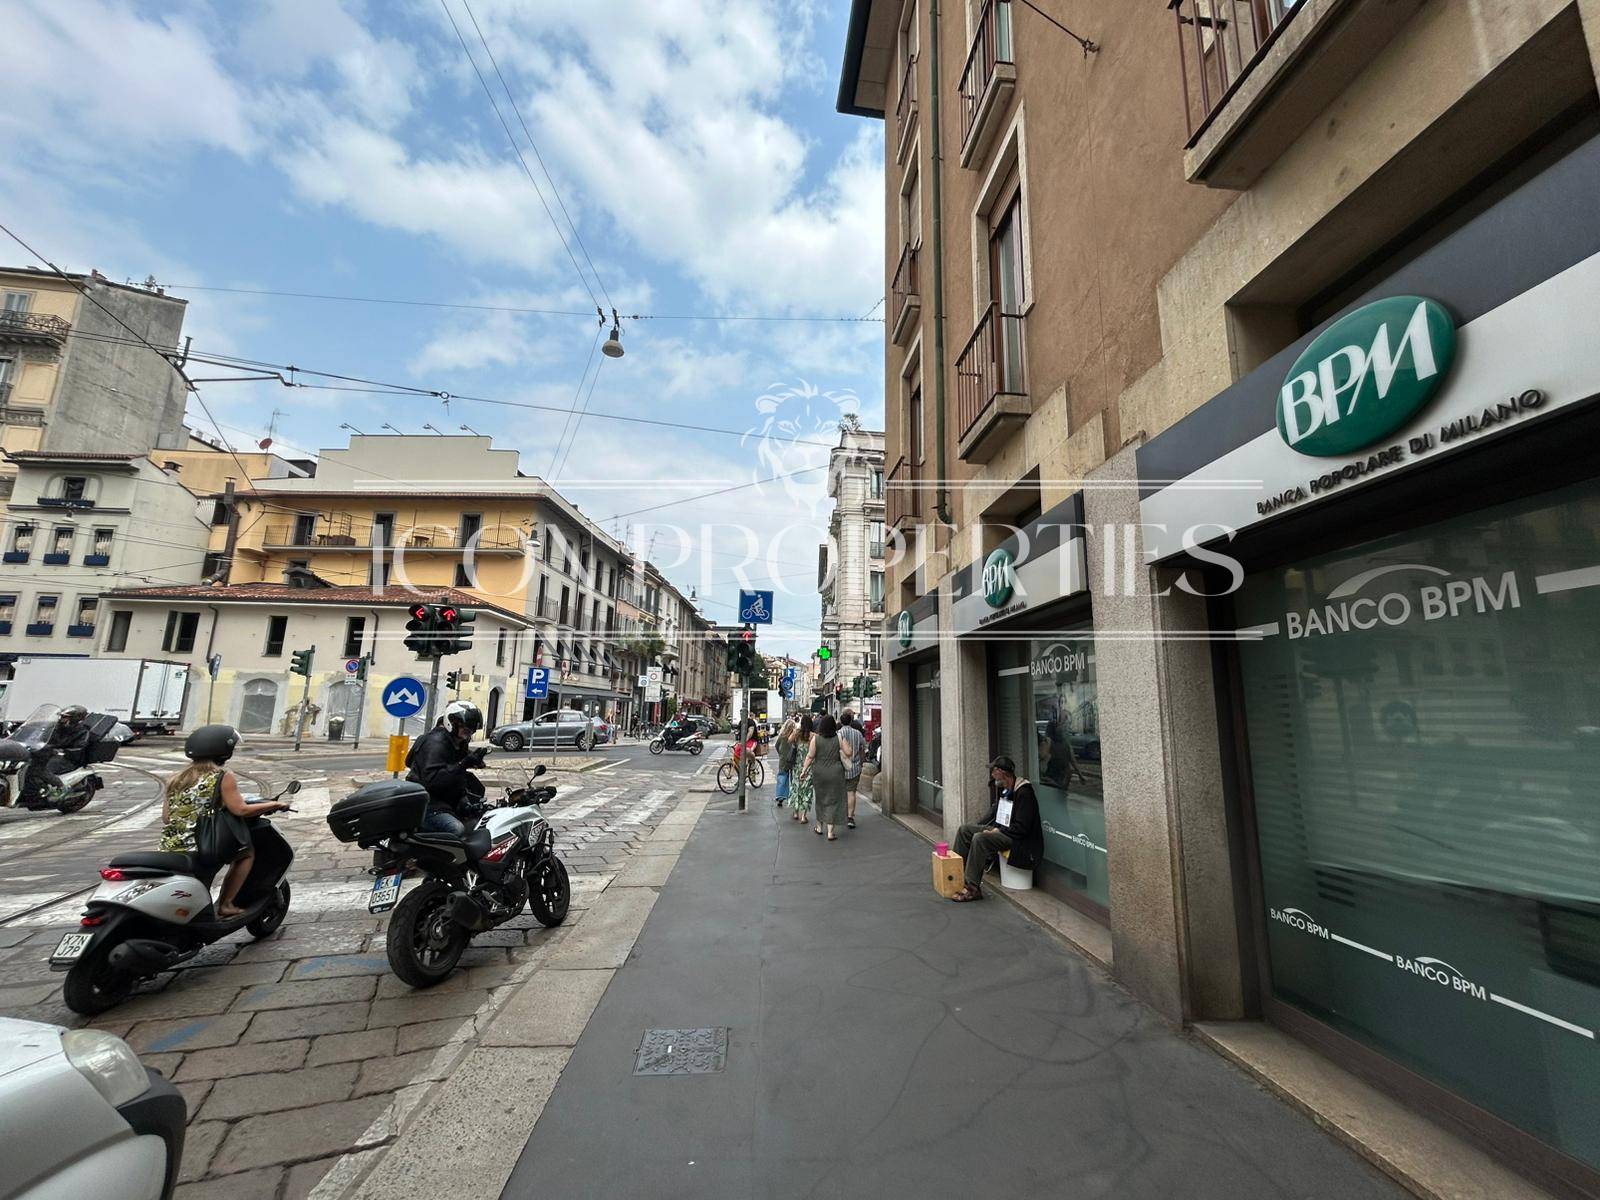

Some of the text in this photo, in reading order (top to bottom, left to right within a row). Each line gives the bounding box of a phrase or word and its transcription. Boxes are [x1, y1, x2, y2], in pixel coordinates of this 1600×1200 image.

[1281, 300, 1438, 446] BPM
[1256, 389, 1543, 515] BANCA POPOLARE DI MILANO
[982, 556, 1010, 598] BPM
[1286, 571, 1521, 640] BANCO BPM
[531, 668, 545, 684] P
[1030, 652, 1085, 676] BANCO BPM
[1270, 907, 1329, 940] BANCO BPM
[1396, 955, 1487, 1001] BANCO BPM
